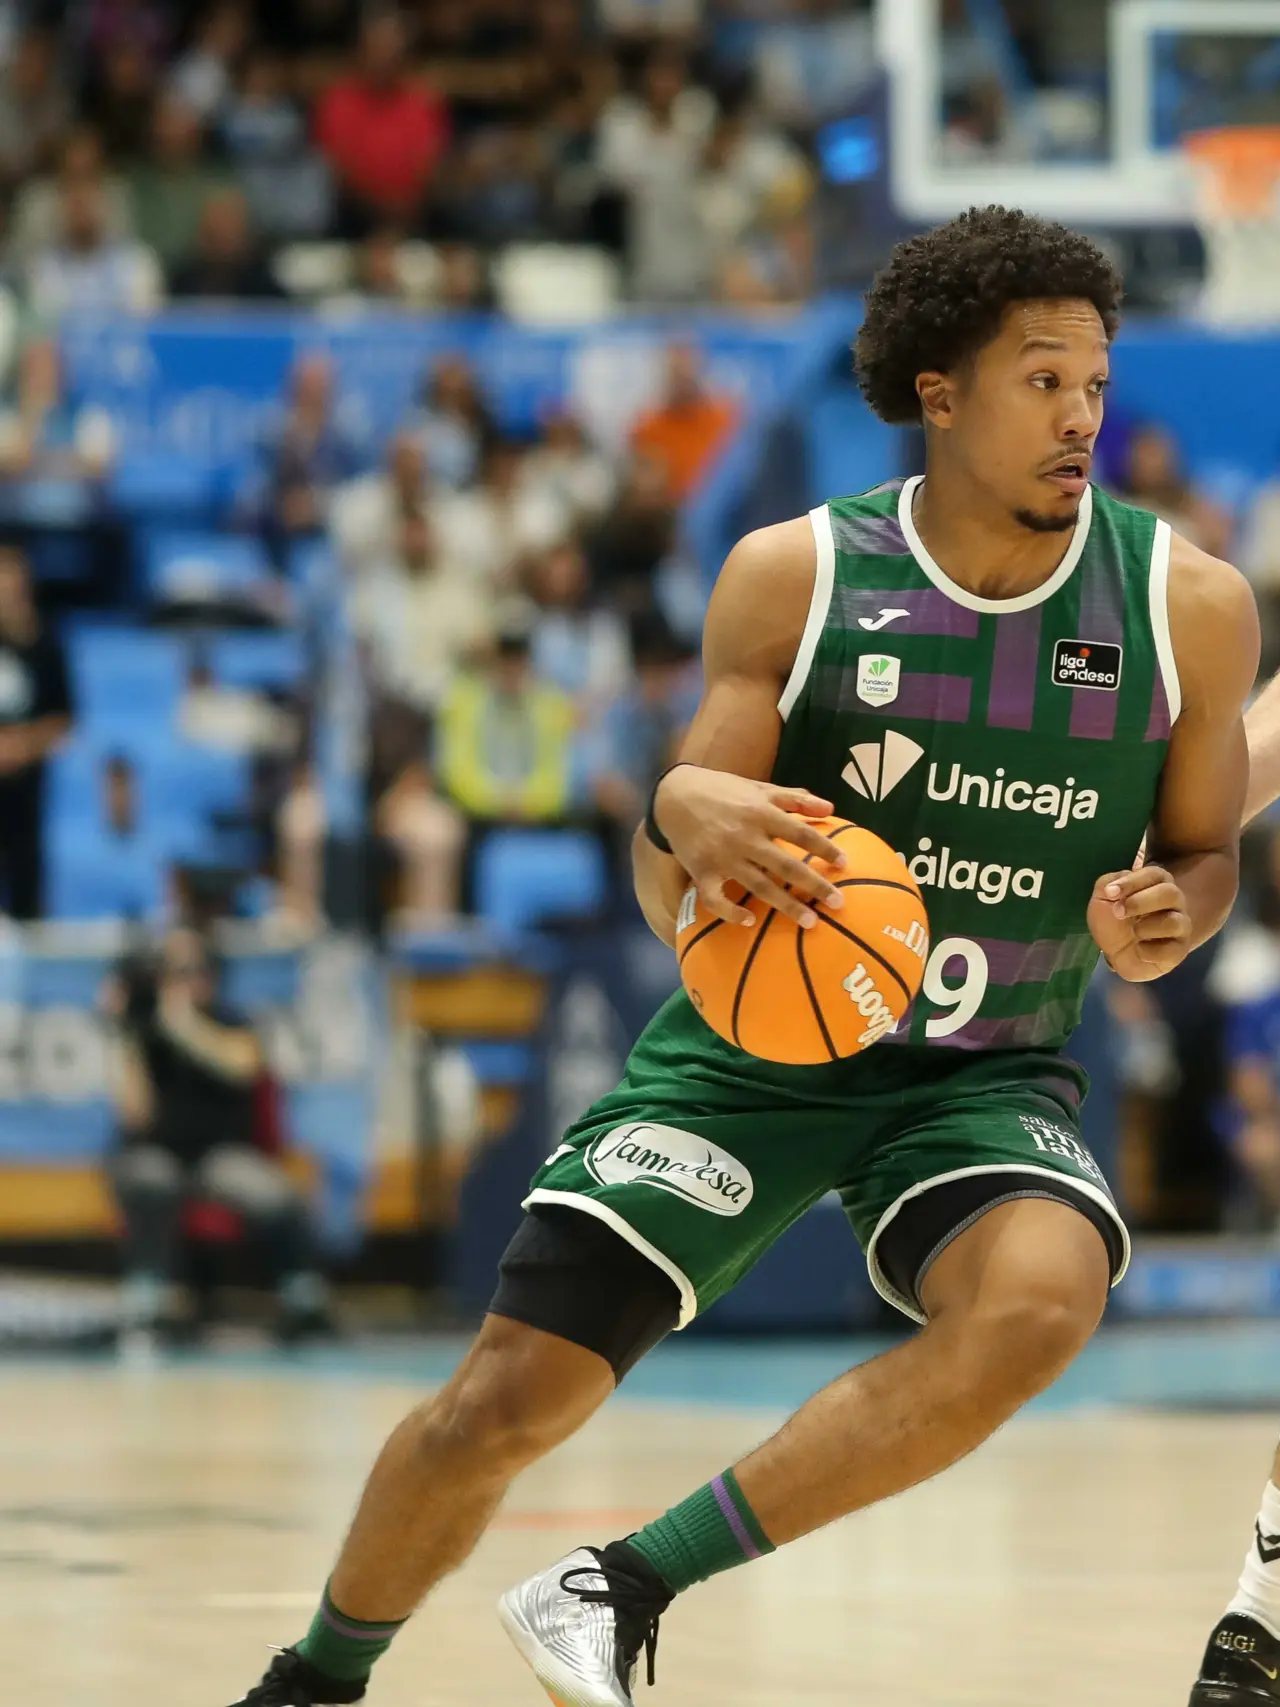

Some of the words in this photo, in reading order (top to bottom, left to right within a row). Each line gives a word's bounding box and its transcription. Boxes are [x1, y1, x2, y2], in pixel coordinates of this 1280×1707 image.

[1058, 668, 1115, 684] endesa
[1060, 653, 1087, 669] liga
[927, 762, 1099, 829] Unicaja
[888, 937, 989, 1038] 9
